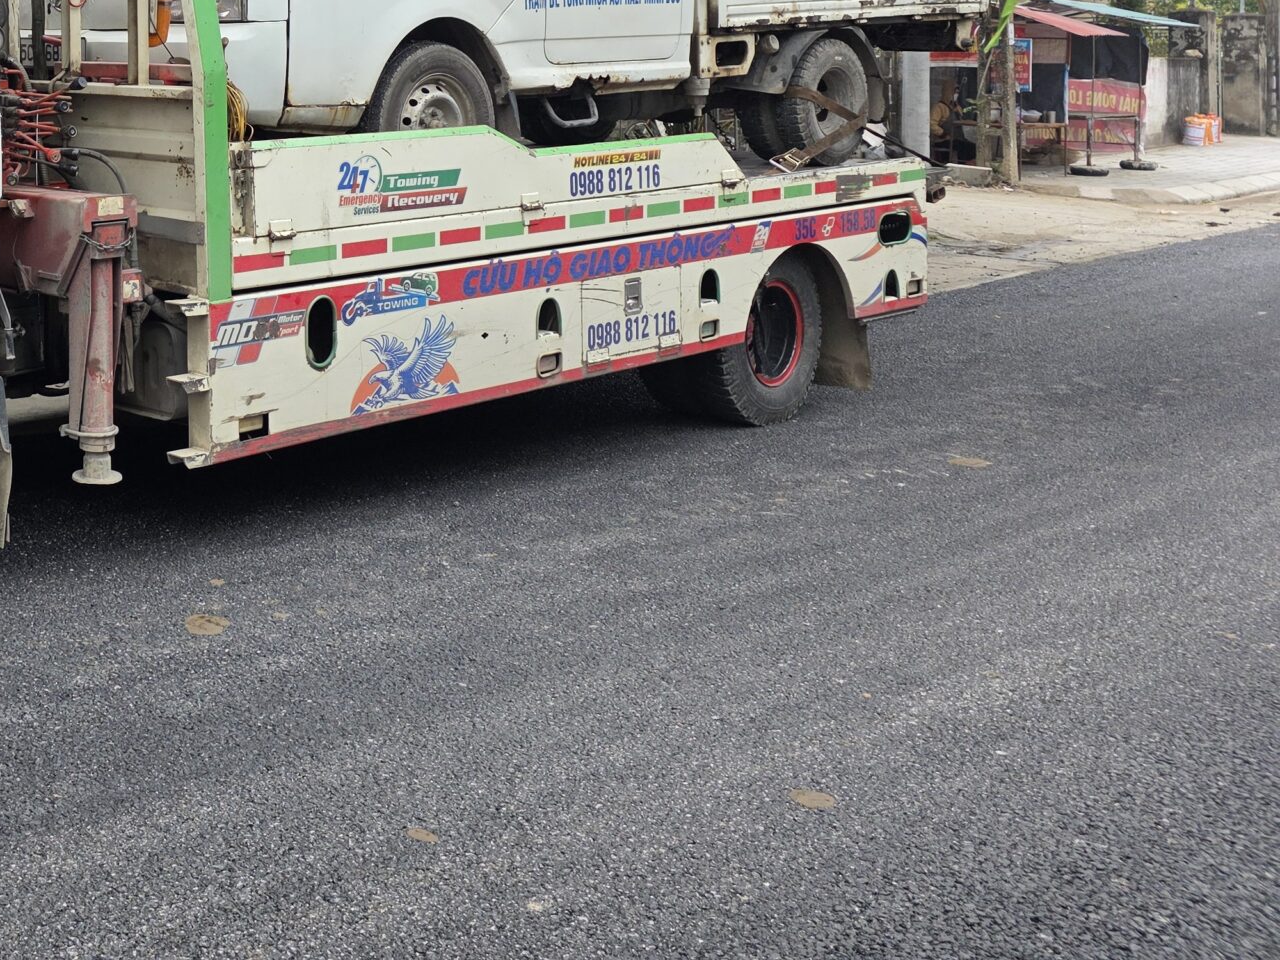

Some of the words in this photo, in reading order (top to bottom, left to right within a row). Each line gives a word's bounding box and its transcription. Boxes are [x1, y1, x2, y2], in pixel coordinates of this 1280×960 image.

[574, 154, 610, 168] HOTLINE
[386, 174, 439, 189] Towing
[569, 169, 603, 197] 0988
[608, 166, 632, 193] 812
[636, 163, 660, 189] 116
[339, 193, 383, 207] Emergency
[387, 191, 459, 209] Recovery
[353, 205, 379, 216] Services
[795, 217, 817, 241] 35C
[840, 208, 876, 233] 158.58
[570, 247, 631, 281] GIAO
[377, 297, 419, 311] TOWING
[278, 313, 303, 324] Motor
[278, 324, 300, 336] port
[588, 319, 621, 350] 0988
[625, 314, 649, 342] 812
[653, 310, 676, 336] 116
